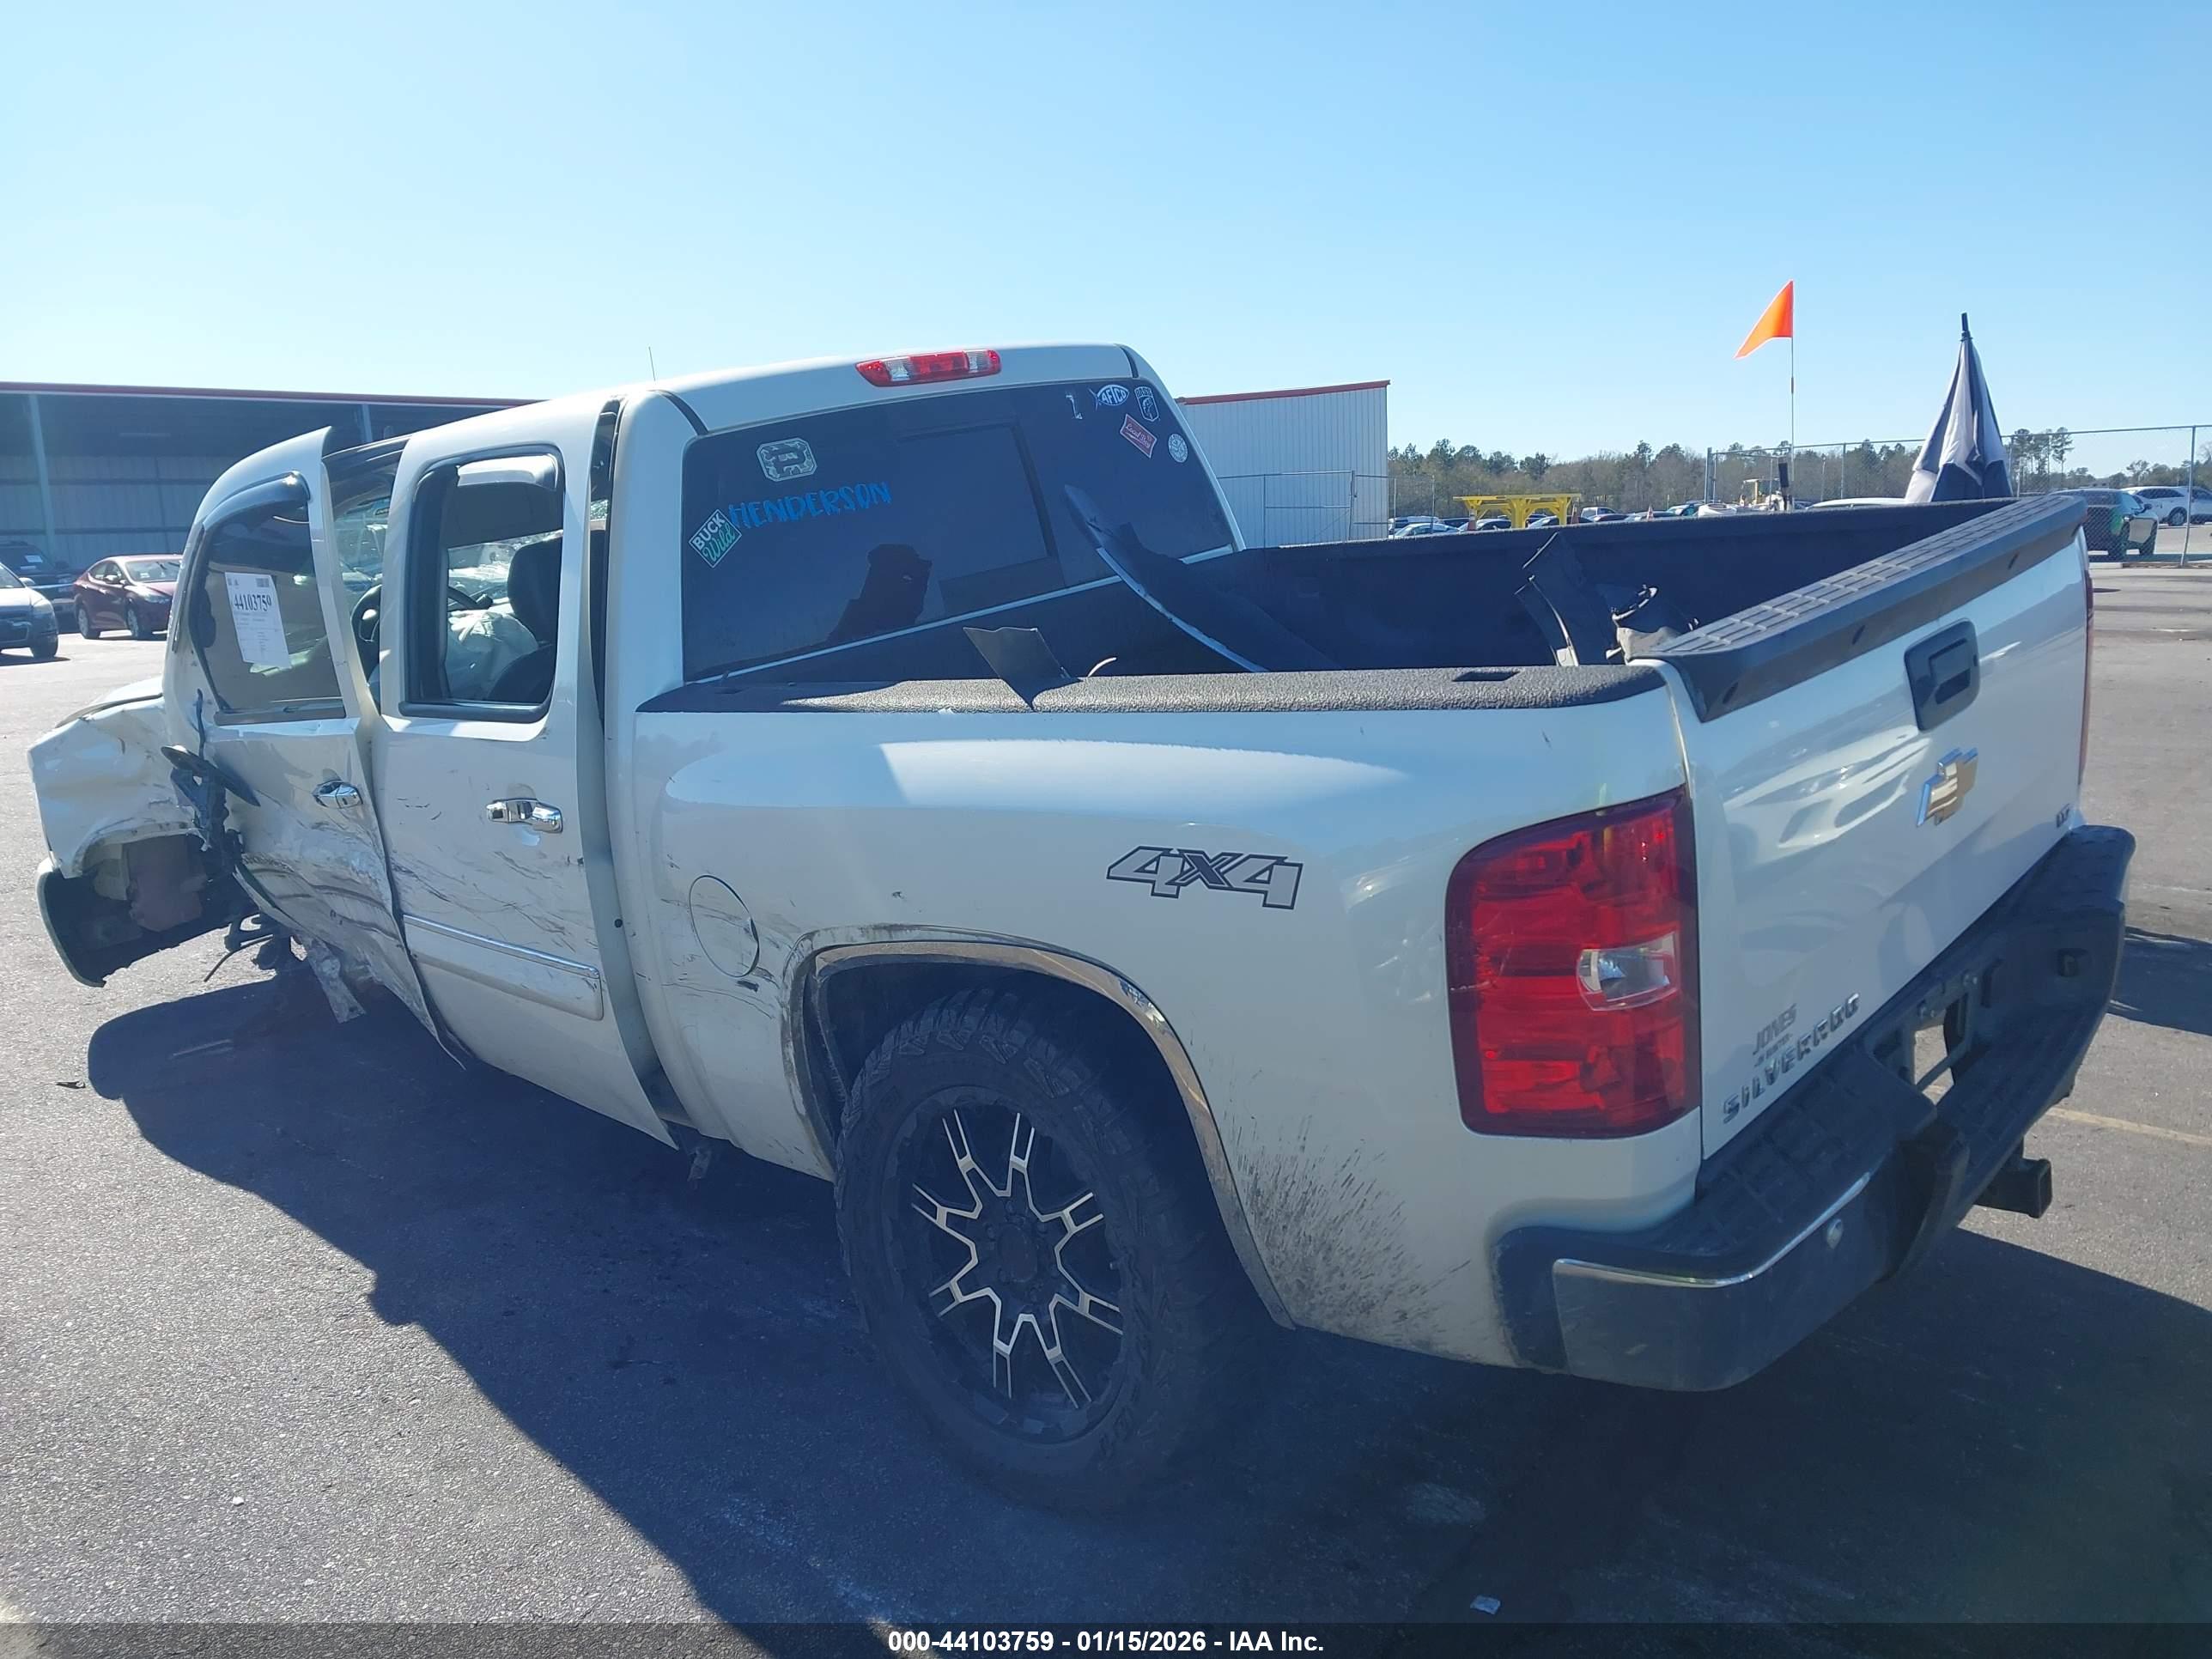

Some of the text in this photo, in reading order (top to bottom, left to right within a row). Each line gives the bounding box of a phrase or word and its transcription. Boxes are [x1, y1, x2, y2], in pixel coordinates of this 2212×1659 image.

[729, 481, 891, 529] HENDERSON
[692, 513, 726, 551] BUCK
[703, 523, 737, 562] Wild
[234, 594, 272, 611] 44103759
[1723, 993, 1859, 1124] SILVERADO
